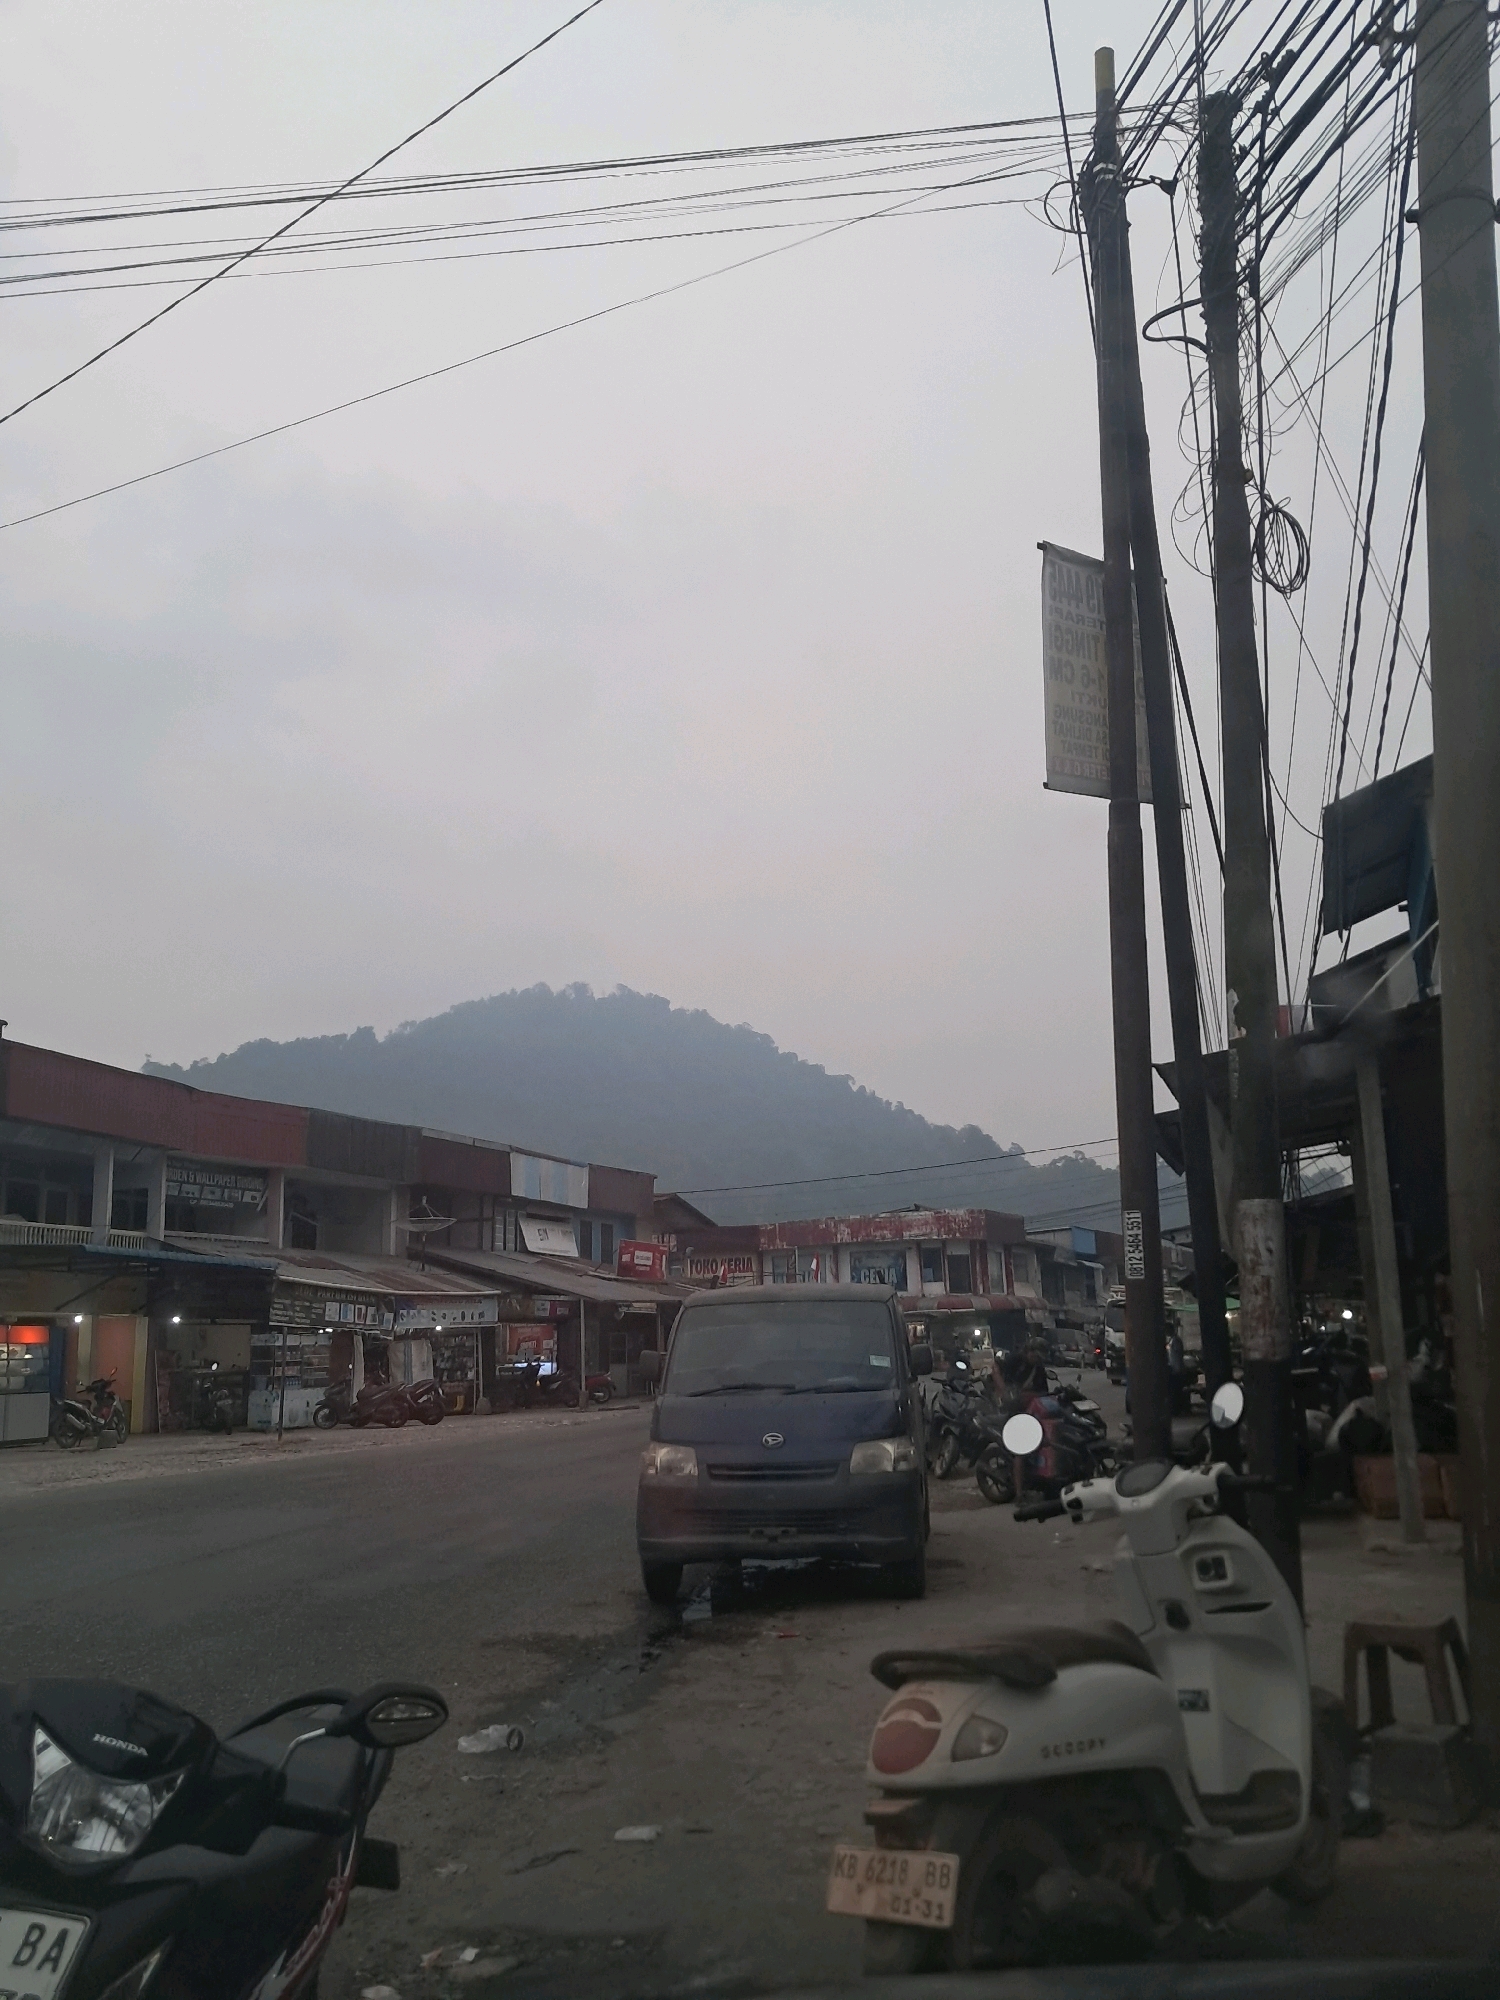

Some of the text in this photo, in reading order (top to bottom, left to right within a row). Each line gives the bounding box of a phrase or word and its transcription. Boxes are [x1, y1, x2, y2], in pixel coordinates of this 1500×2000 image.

[196, 1171, 236, 1187] WALLPAPER
[1126, 1211, 1143, 1277] 0812 5464 5511
[690, 1257, 718, 1276] TOKO
[92, 1732, 148, 1757] HONDA
[834, 1852, 858, 1879] KB
[865, 1854, 909, 1885] 6218
[12, 1922, 70, 1973] BA
